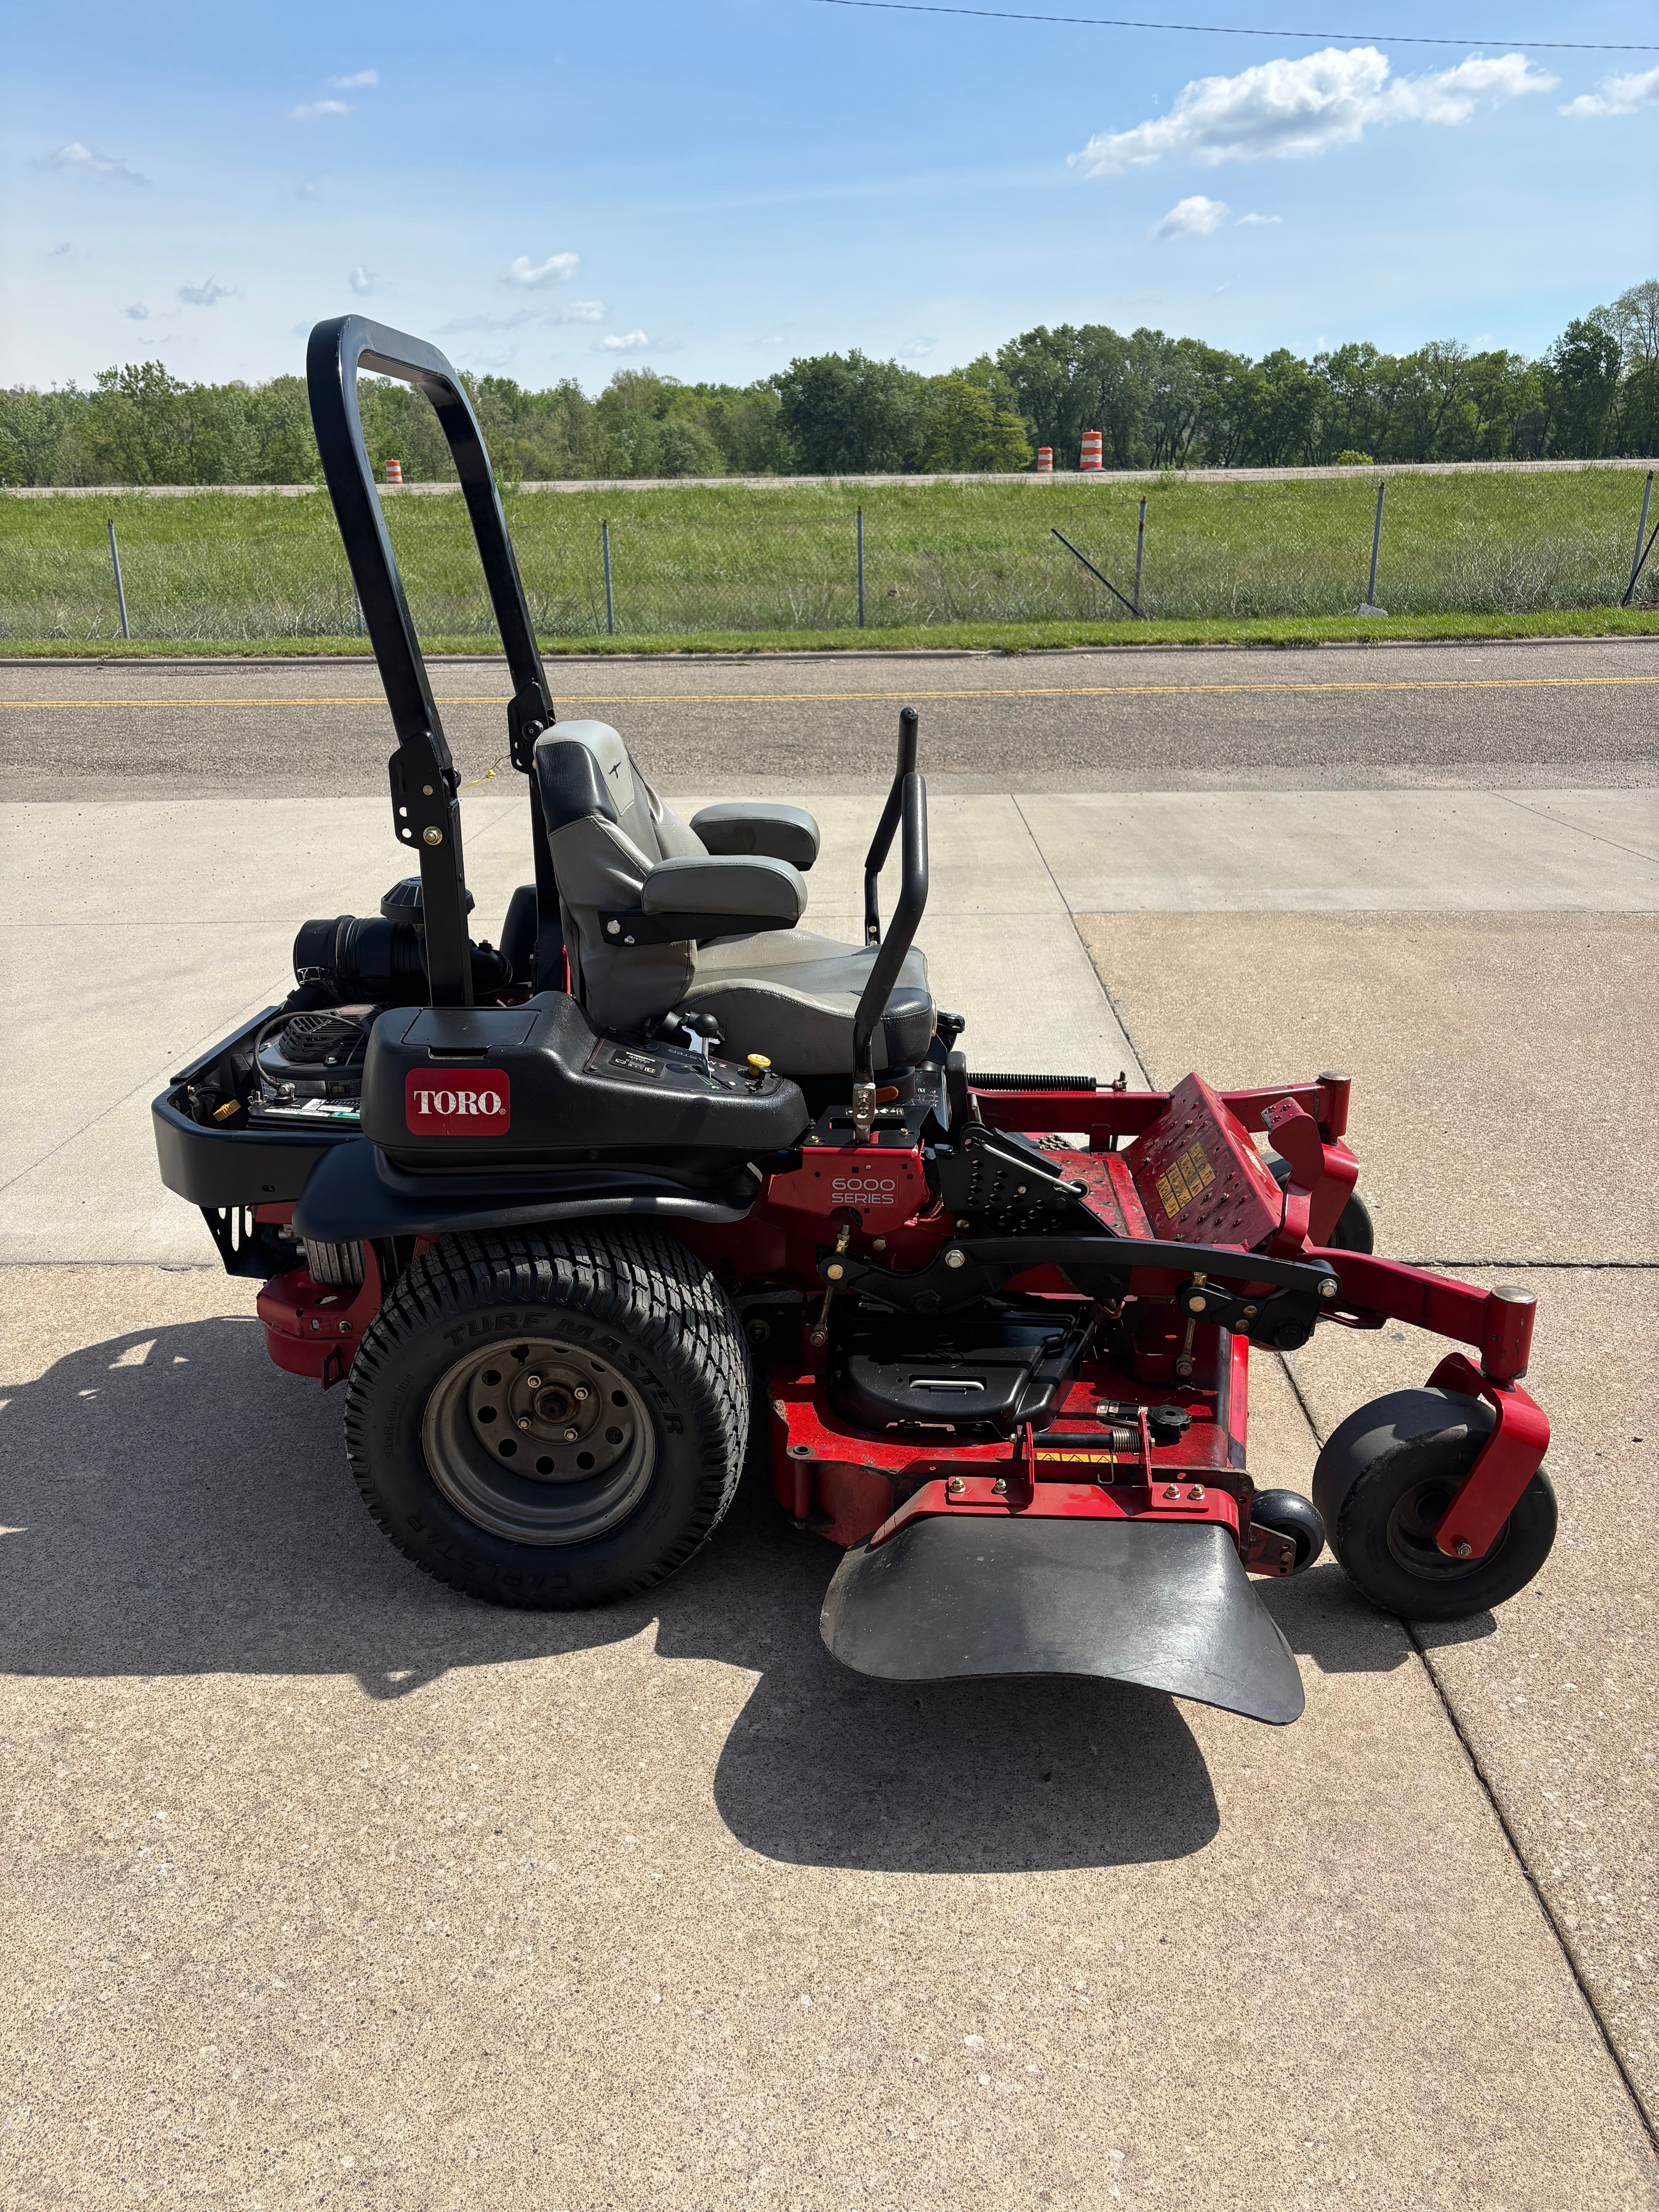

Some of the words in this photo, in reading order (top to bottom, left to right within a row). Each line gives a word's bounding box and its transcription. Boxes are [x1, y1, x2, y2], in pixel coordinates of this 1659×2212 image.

[832, 1178, 895, 1191] 6000
[831, 1193, 894, 1204] SERIES
[443, 1312, 547, 1346] TURF
[555, 1317, 686, 1436] MASTER
